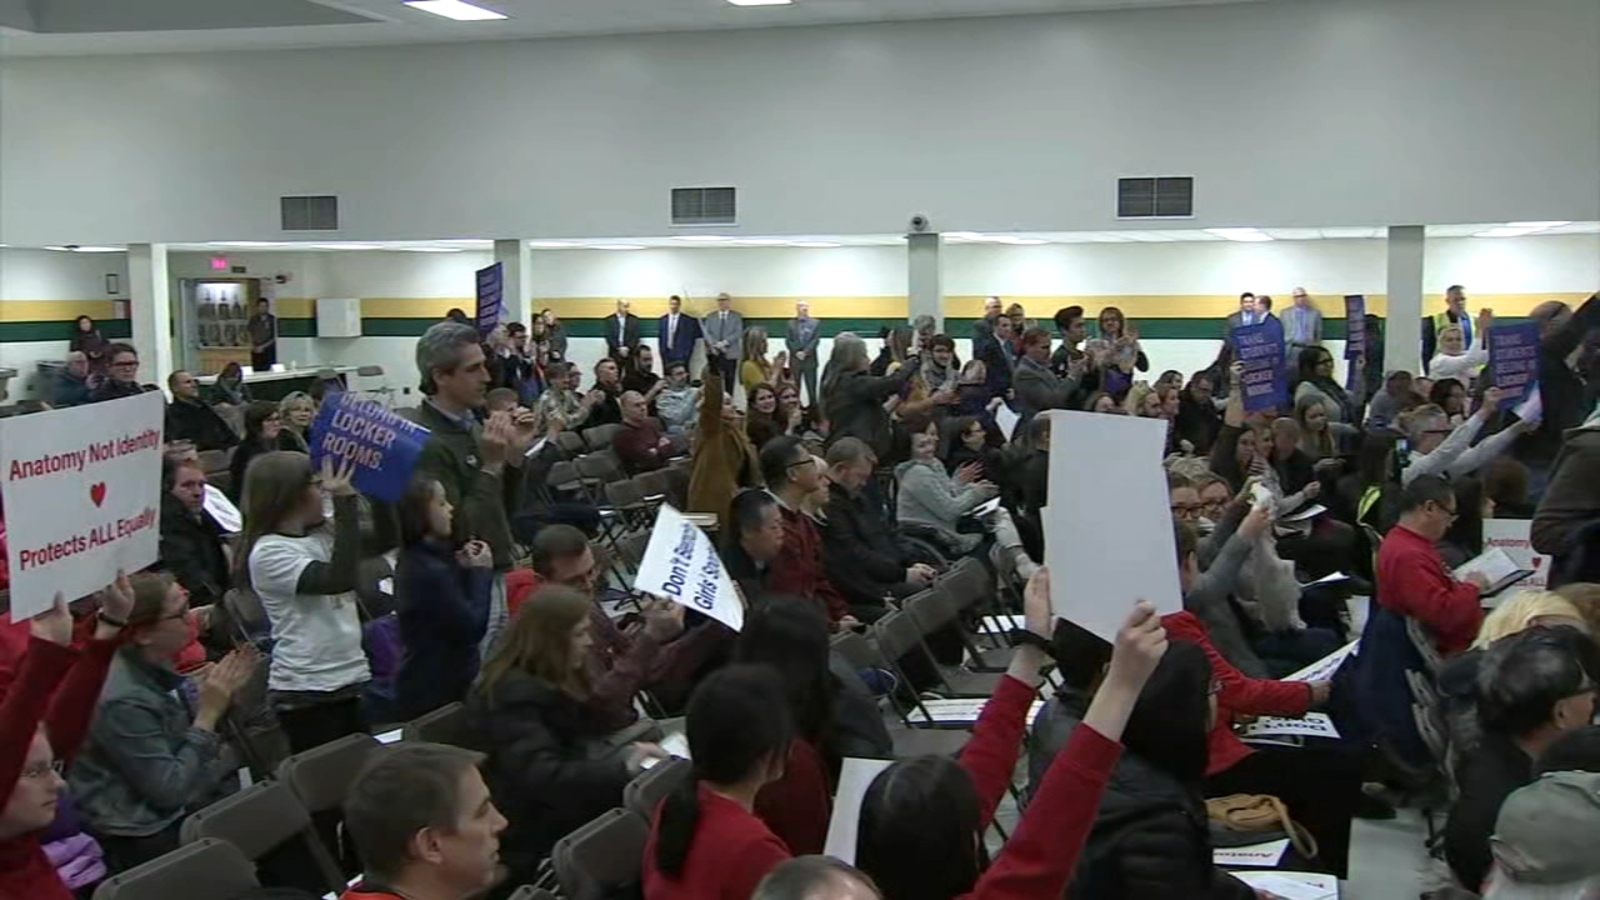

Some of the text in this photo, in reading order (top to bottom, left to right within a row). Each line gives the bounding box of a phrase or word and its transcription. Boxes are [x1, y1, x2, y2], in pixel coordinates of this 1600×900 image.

[331, 409, 396, 449] LOCKER
[9, 428, 161, 482] Anatomy Not Identity
[19, 508, 157, 570] Protects ALL Equally
[661, 556, 691, 596] Don't
